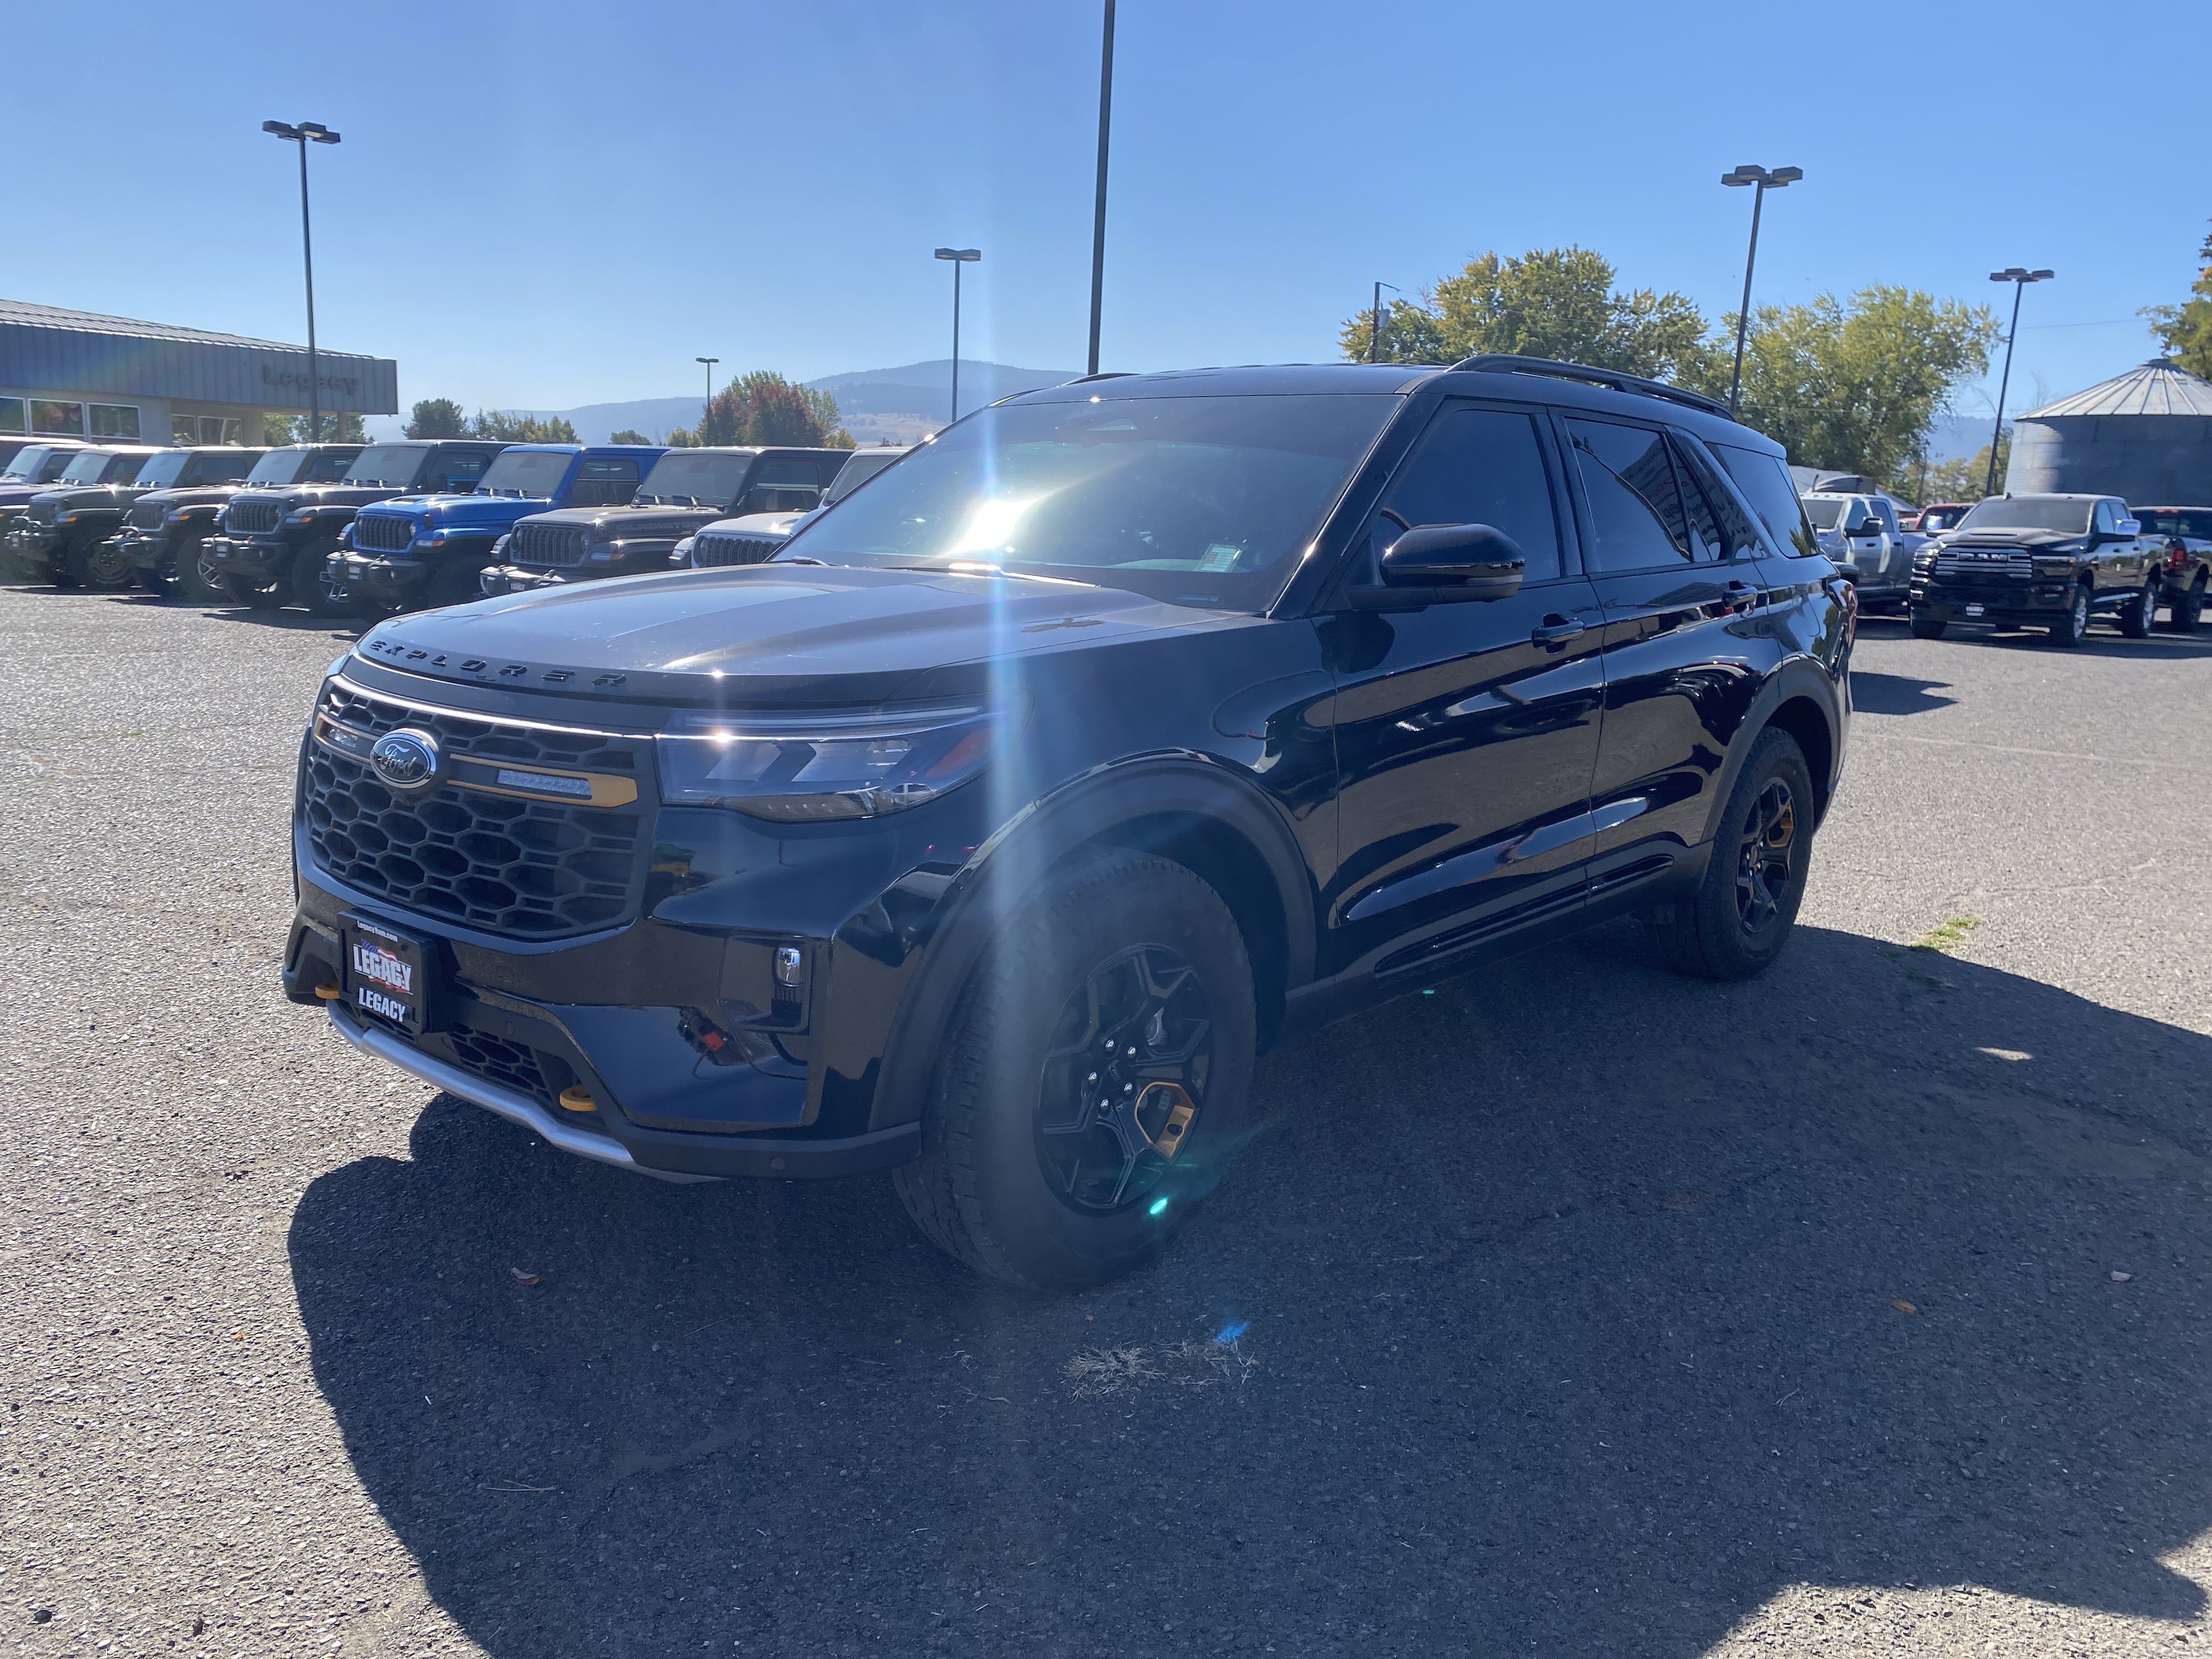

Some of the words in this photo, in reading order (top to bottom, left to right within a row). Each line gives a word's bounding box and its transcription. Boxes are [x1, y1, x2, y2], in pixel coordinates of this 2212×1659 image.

[616, 521, 701, 531] GLADIATOR
[369, 640, 627, 686] EXPLORER
[377, 743, 417, 776] Ford
[353, 945, 411, 991] LEGACY
[358, 987, 405, 1023] LEGACY
